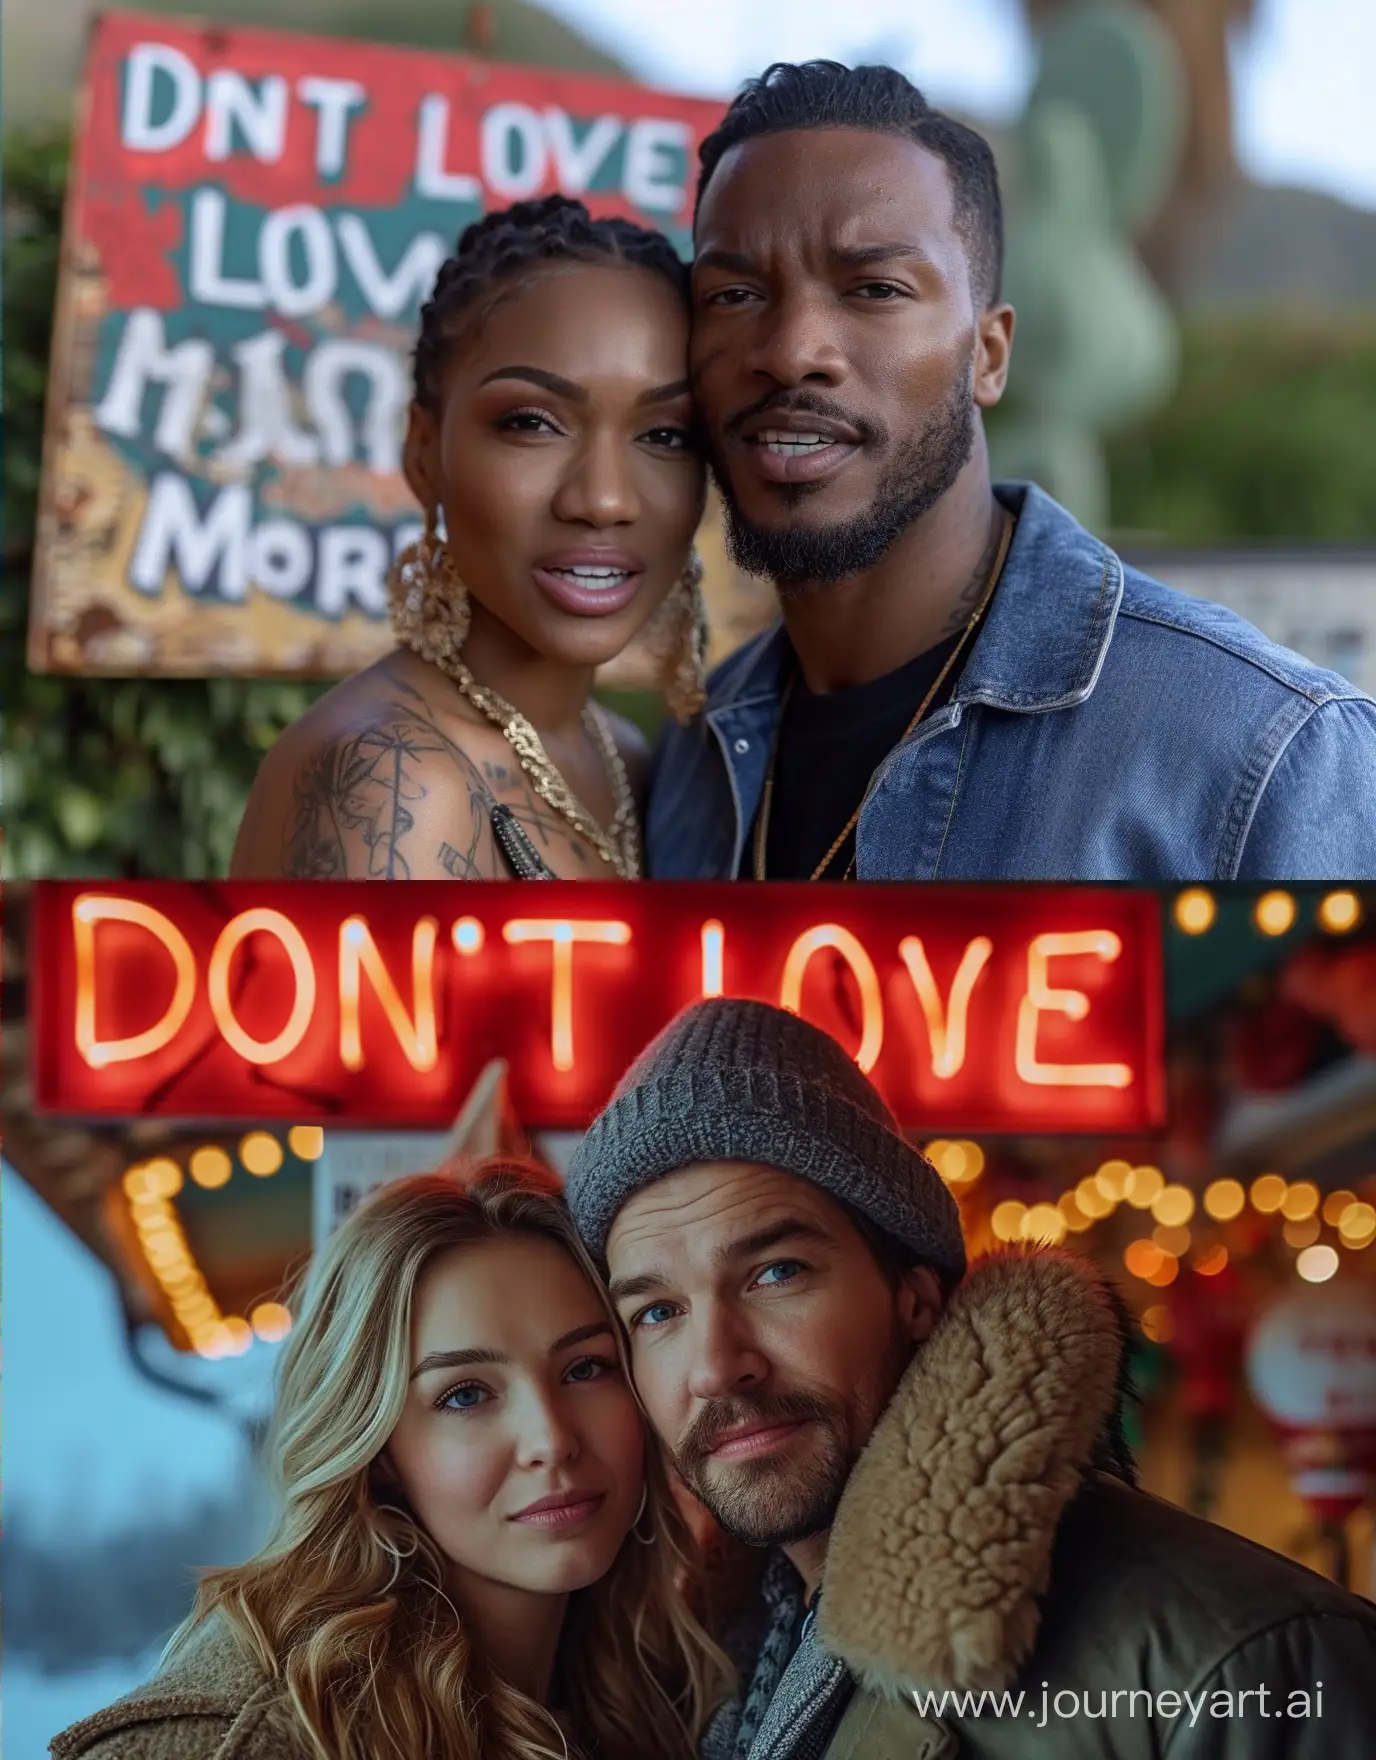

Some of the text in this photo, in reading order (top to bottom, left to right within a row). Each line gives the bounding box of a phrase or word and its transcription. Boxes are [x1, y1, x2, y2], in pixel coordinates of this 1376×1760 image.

[122, 40, 692, 213] DNT LOVE
[72, 894, 632, 1072] DON'T
